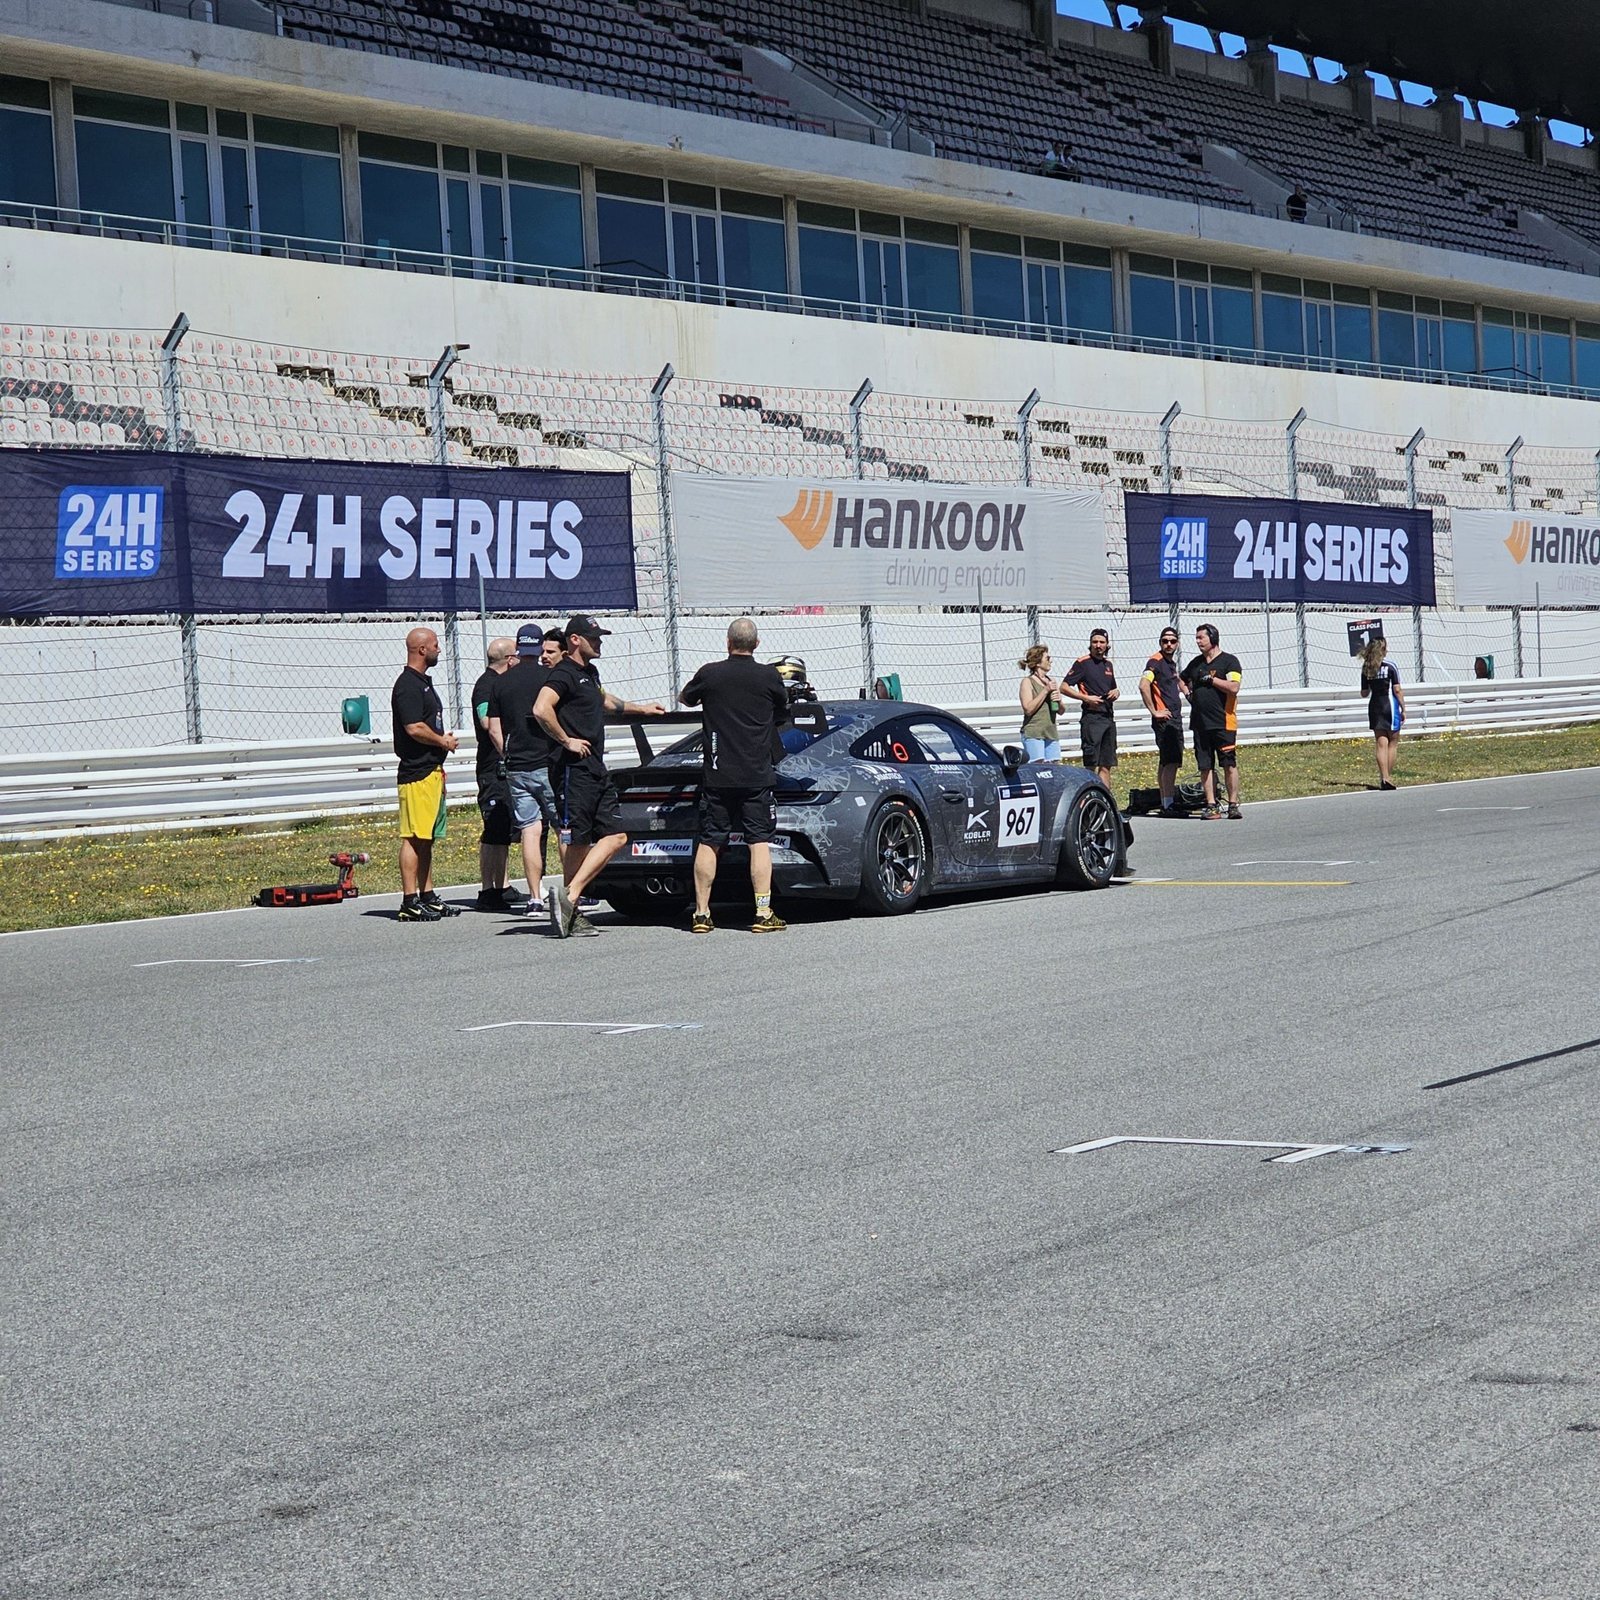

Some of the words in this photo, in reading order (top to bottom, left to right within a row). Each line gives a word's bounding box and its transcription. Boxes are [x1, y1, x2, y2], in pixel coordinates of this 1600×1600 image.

[66, 494, 157, 548] 24H
[222, 490, 362, 579] 24H
[379, 495, 584, 580] SERIES
[1164, 522, 1206, 558] 24H
[1233, 519, 1297, 579] 24H
[1303, 522, 1409, 585] SERIES
[63, 550, 155, 572] SERIES
[886, 558, 949, 594] driving
[954, 560, 1026, 587] emotion
[1163, 559, 1205, 574] SERIES
[1366, 622, 1380, 630] POLE
[1005, 806, 1036, 837] 967
